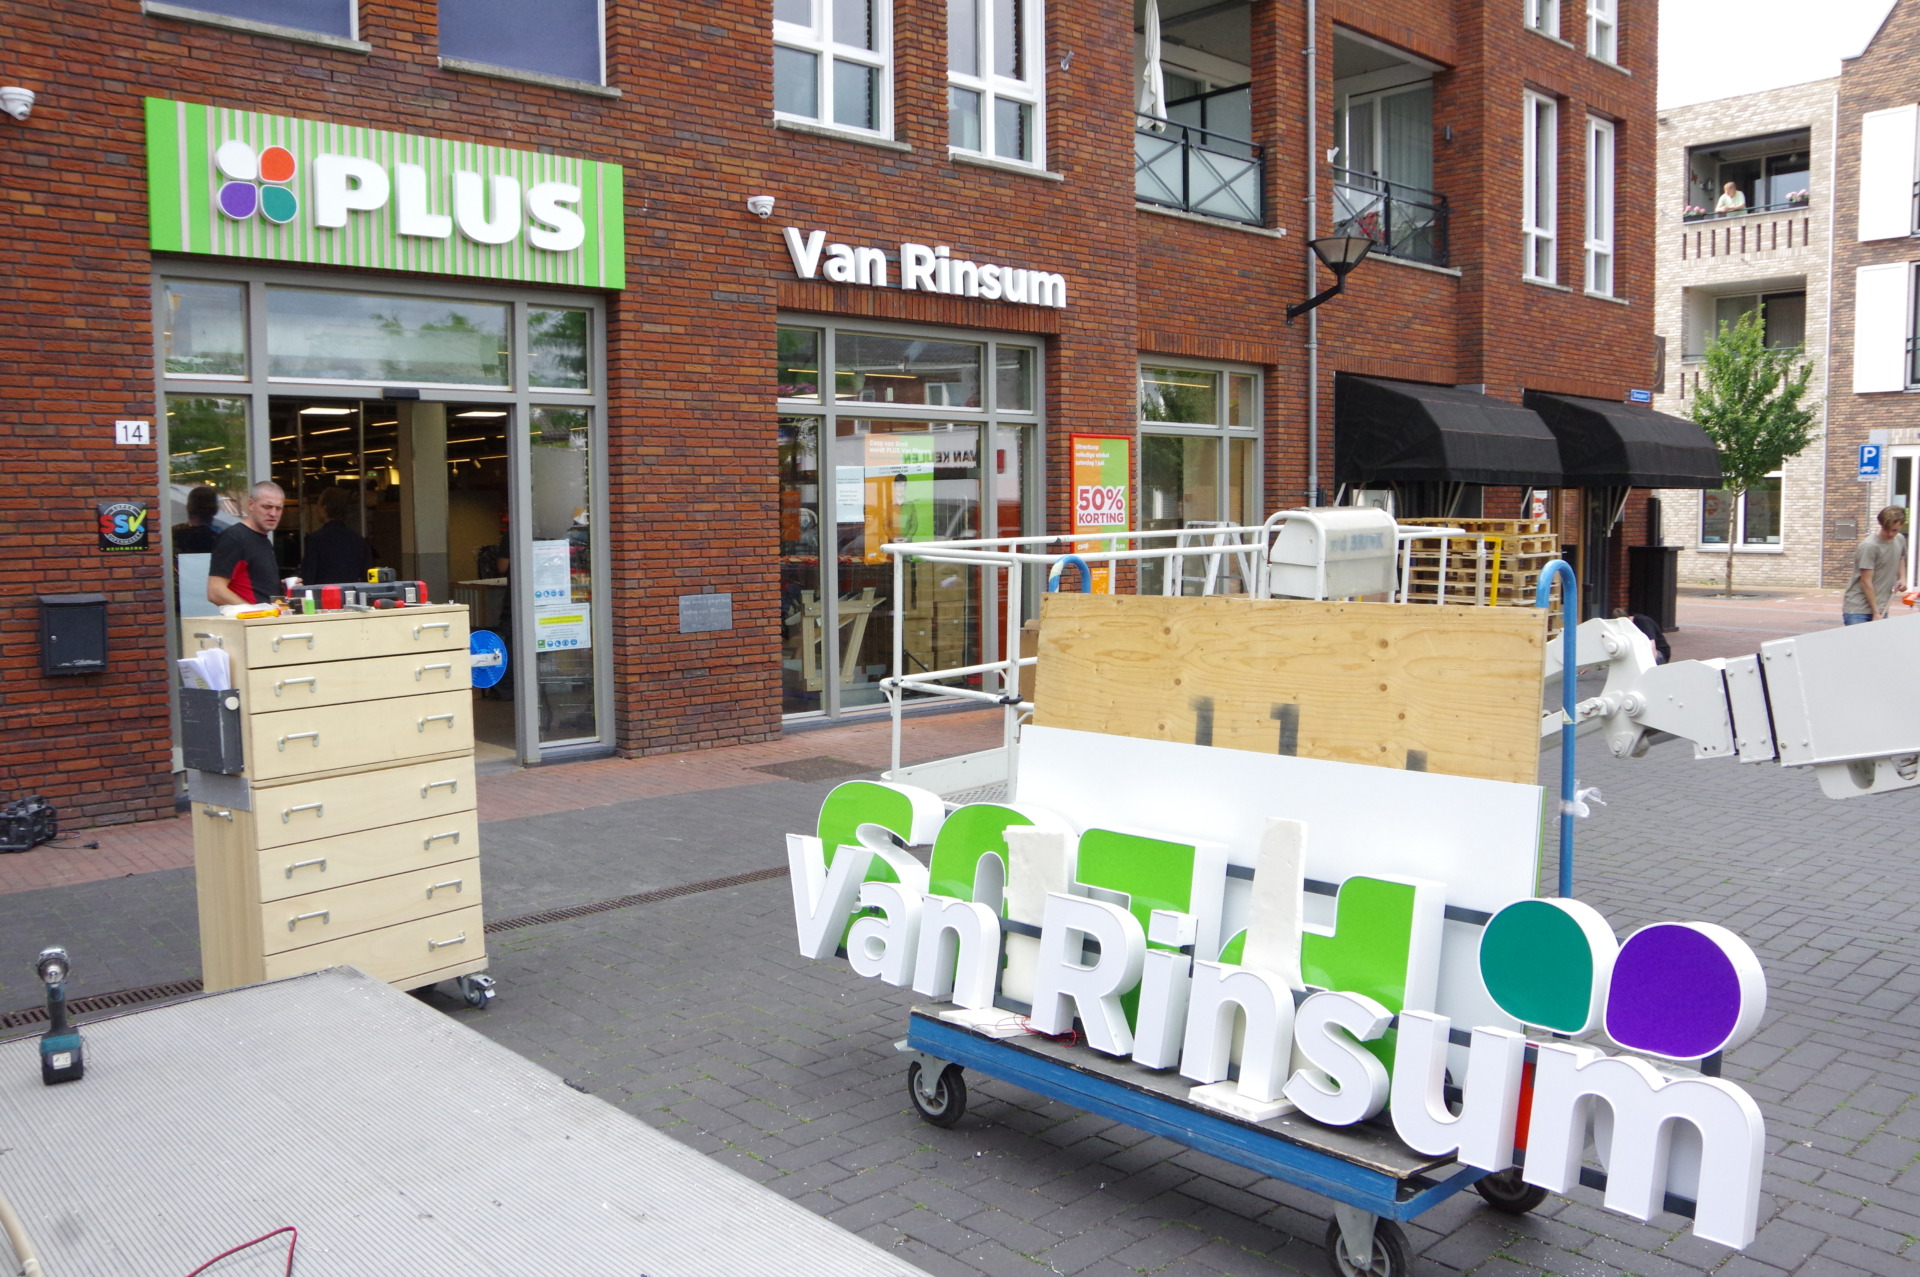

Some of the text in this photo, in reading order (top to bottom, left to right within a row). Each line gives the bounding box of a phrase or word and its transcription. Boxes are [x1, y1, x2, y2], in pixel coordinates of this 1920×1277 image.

[313, 153, 586, 253] PLUS
[782, 225, 1067, 309] Van Rinsum
[122, 424, 143, 442] 14
[1863, 446, 1877, 464] P
[1078, 488, 1124, 511] 50%
[1078, 512, 1124, 524] KORTING
[786, 832, 1765, 1249] Van Rinsum
